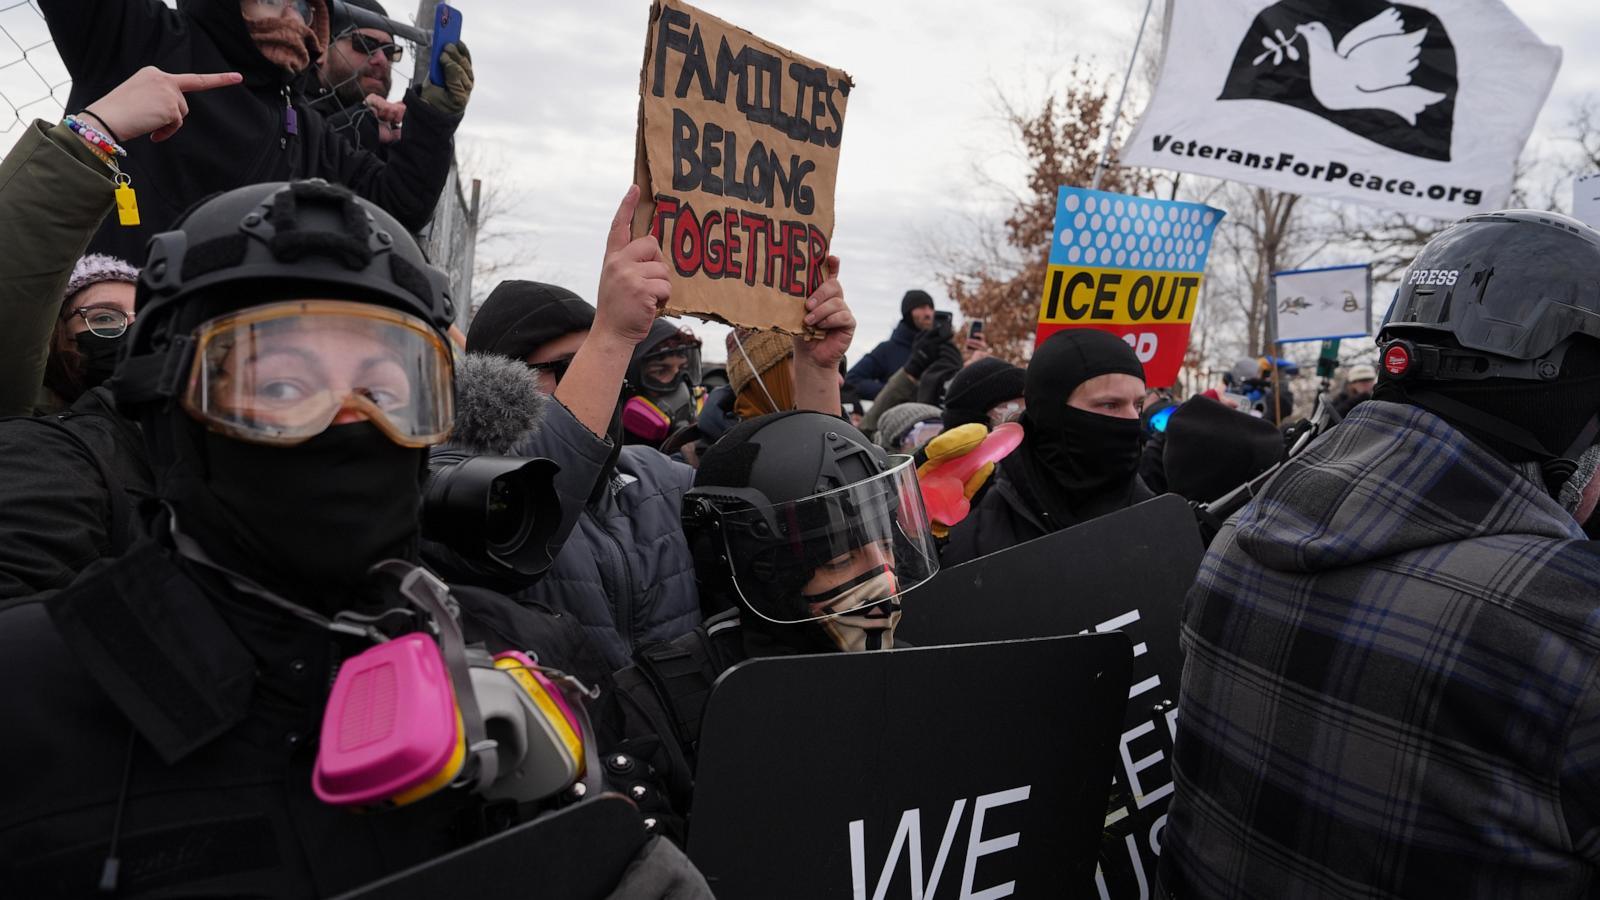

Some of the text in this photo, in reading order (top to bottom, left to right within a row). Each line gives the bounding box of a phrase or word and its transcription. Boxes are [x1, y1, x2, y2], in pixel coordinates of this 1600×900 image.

[652, 4, 851, 148] FAMILIES
[672, 107, 816, 216] BELONG
[1151, 134, 1483, 206] VeteransForPeace.org
[652, 192, 829, 298] TOGETHER
[1046, 270, 1199, 321] ICE OUT
[1407, 269, 1459, 286] PRESS
[848, 784, 1031, 900] WE
